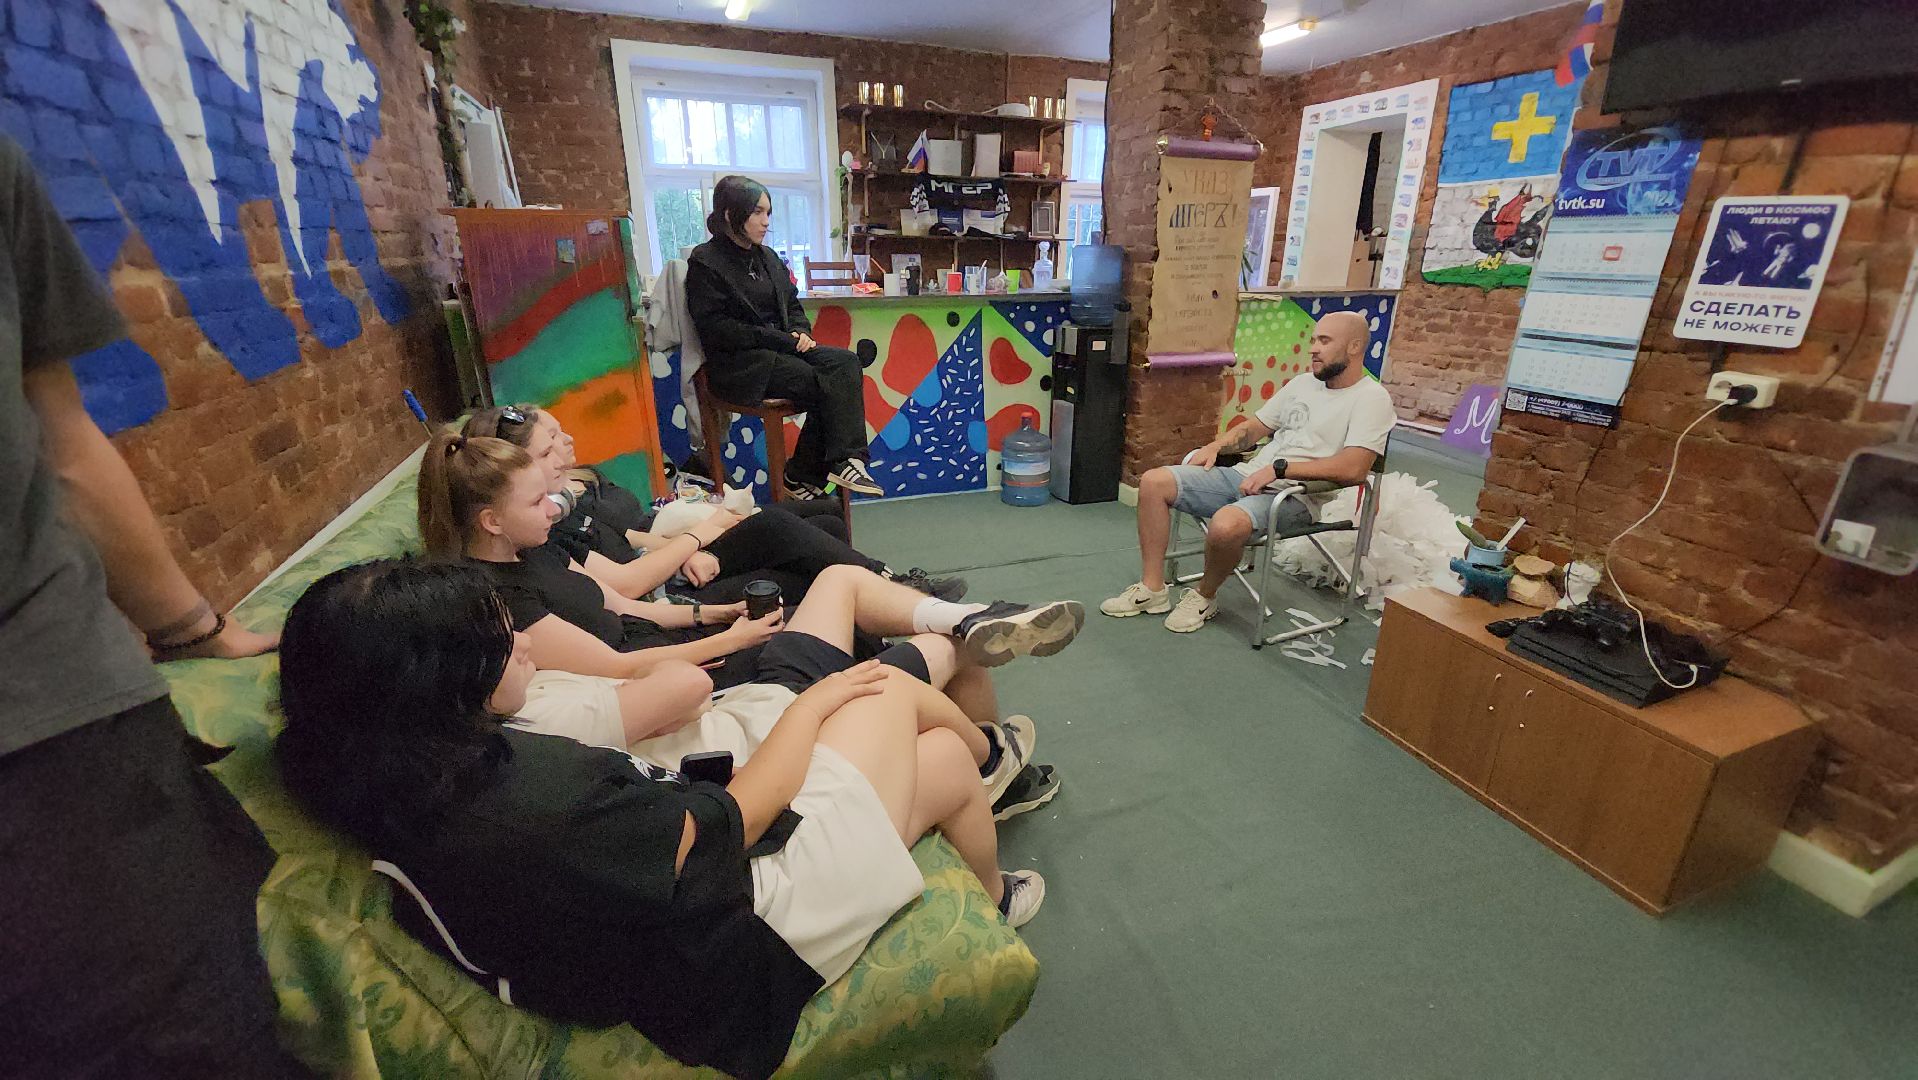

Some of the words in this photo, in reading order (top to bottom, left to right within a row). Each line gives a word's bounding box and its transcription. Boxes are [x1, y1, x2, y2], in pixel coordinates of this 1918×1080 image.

[930, 179, 993, 195] МГЕР
[1558, 196, 1606, 211] tvtk.su
[1726, 206, 1764, 215] ЛЮДИ
[1765, 206, 1773, 214] В
[1775, 206, 1831, 215] КОСМОС
[1749, 216, 1800, 225] ЛЕТАЮТ
[1689, 299, 1802, 320] СДЕЛАТЬ
[1683, 317, 1707, 329] НЕ
[1712, 320, 1797, 337] МОЖЕТЕ
